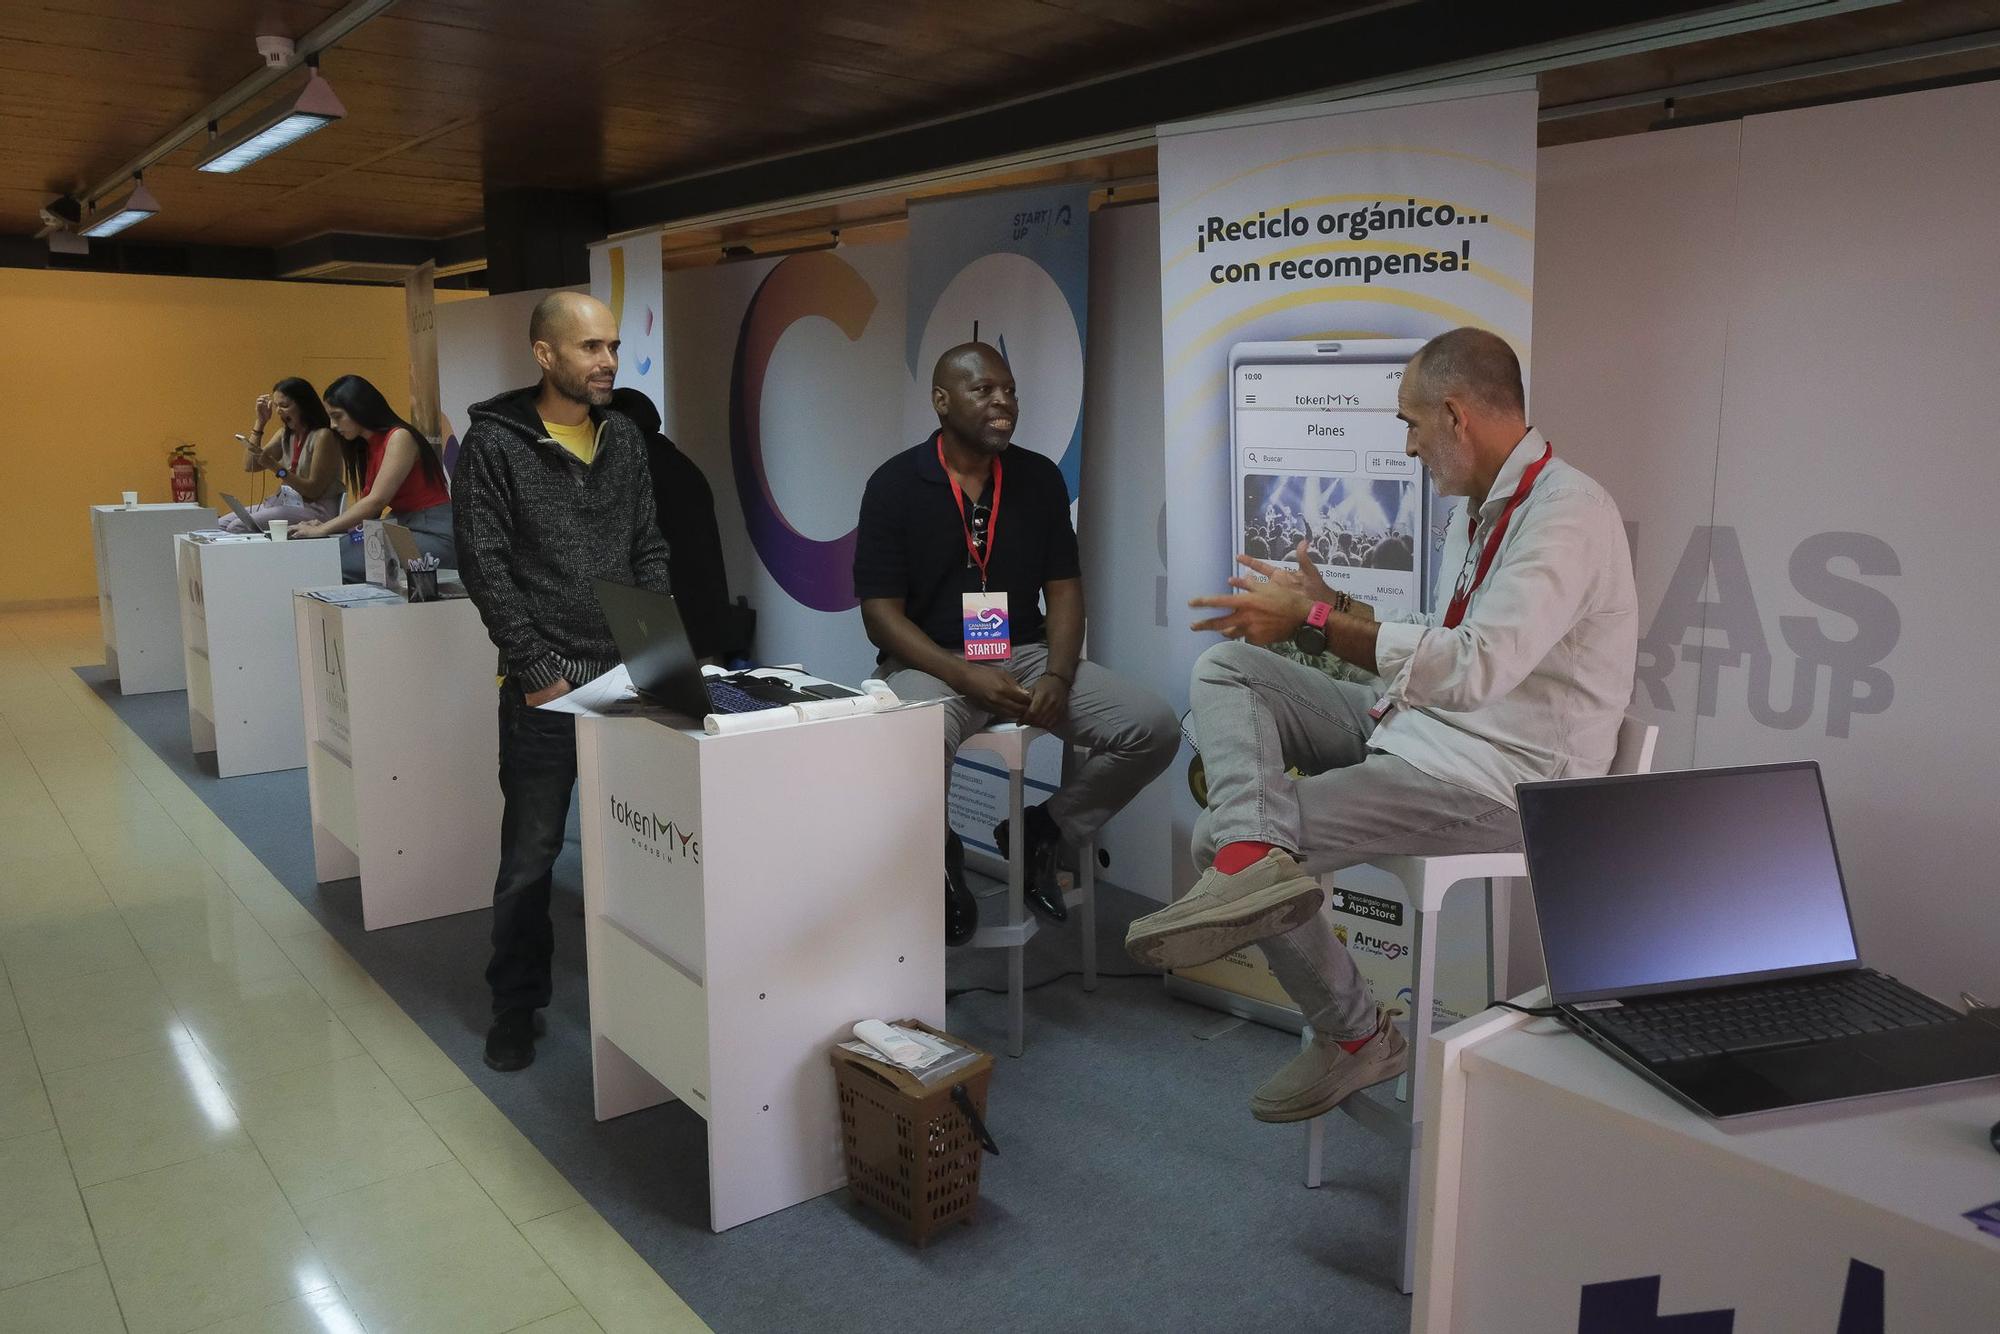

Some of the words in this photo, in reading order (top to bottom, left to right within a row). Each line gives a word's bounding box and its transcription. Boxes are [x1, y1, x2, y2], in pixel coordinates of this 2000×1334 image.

[1013, 209, 1049, 226] START
[1198, 208, 1309, 252] ¡Reciclo
[1316, 199, 1488, 240] orgánico...
[1013, 227, 1028, 240] UP
[1210, 262, 1260, 284] con
[1269, 240, 1470, 283] recompensa!
[1307, 424, 1345, 437] Planes
[1263, 455, 1283, 463] Buscar
[1385, 459, 1406, 467] Filtros
[1325, 570, 1351, 579] Stones
[967, 643, 1007, 656] STARTUP
[1632, 638, 1895, 739] RTUP
[1349, 901, 1369, 915] App
[1370, 906, 1396, 920] Store
